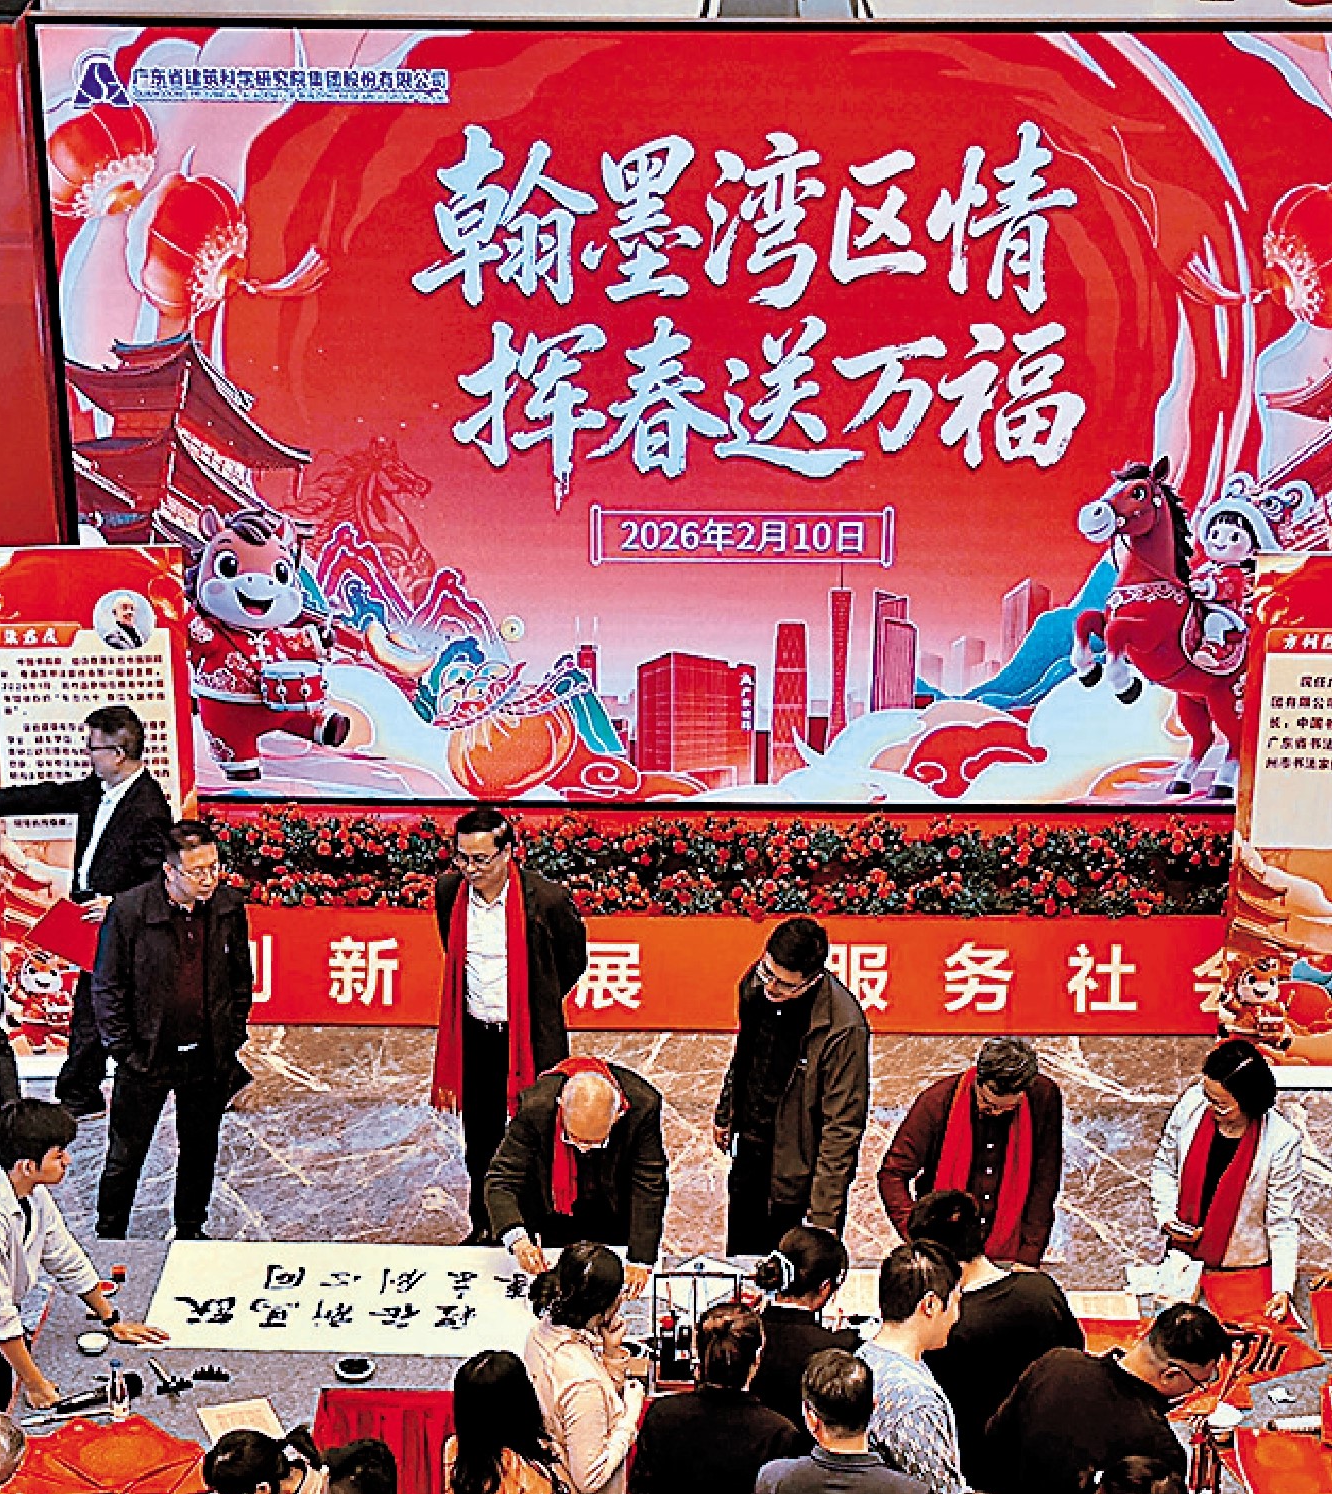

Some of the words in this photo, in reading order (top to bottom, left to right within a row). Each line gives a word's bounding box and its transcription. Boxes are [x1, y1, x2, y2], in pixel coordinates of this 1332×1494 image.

[412, 122, 1080, 315] 翰墨湾区情
[452, 318, 1088, 508] 挥春送万福
[619, 518, 866, 558] 2026年2月10日
